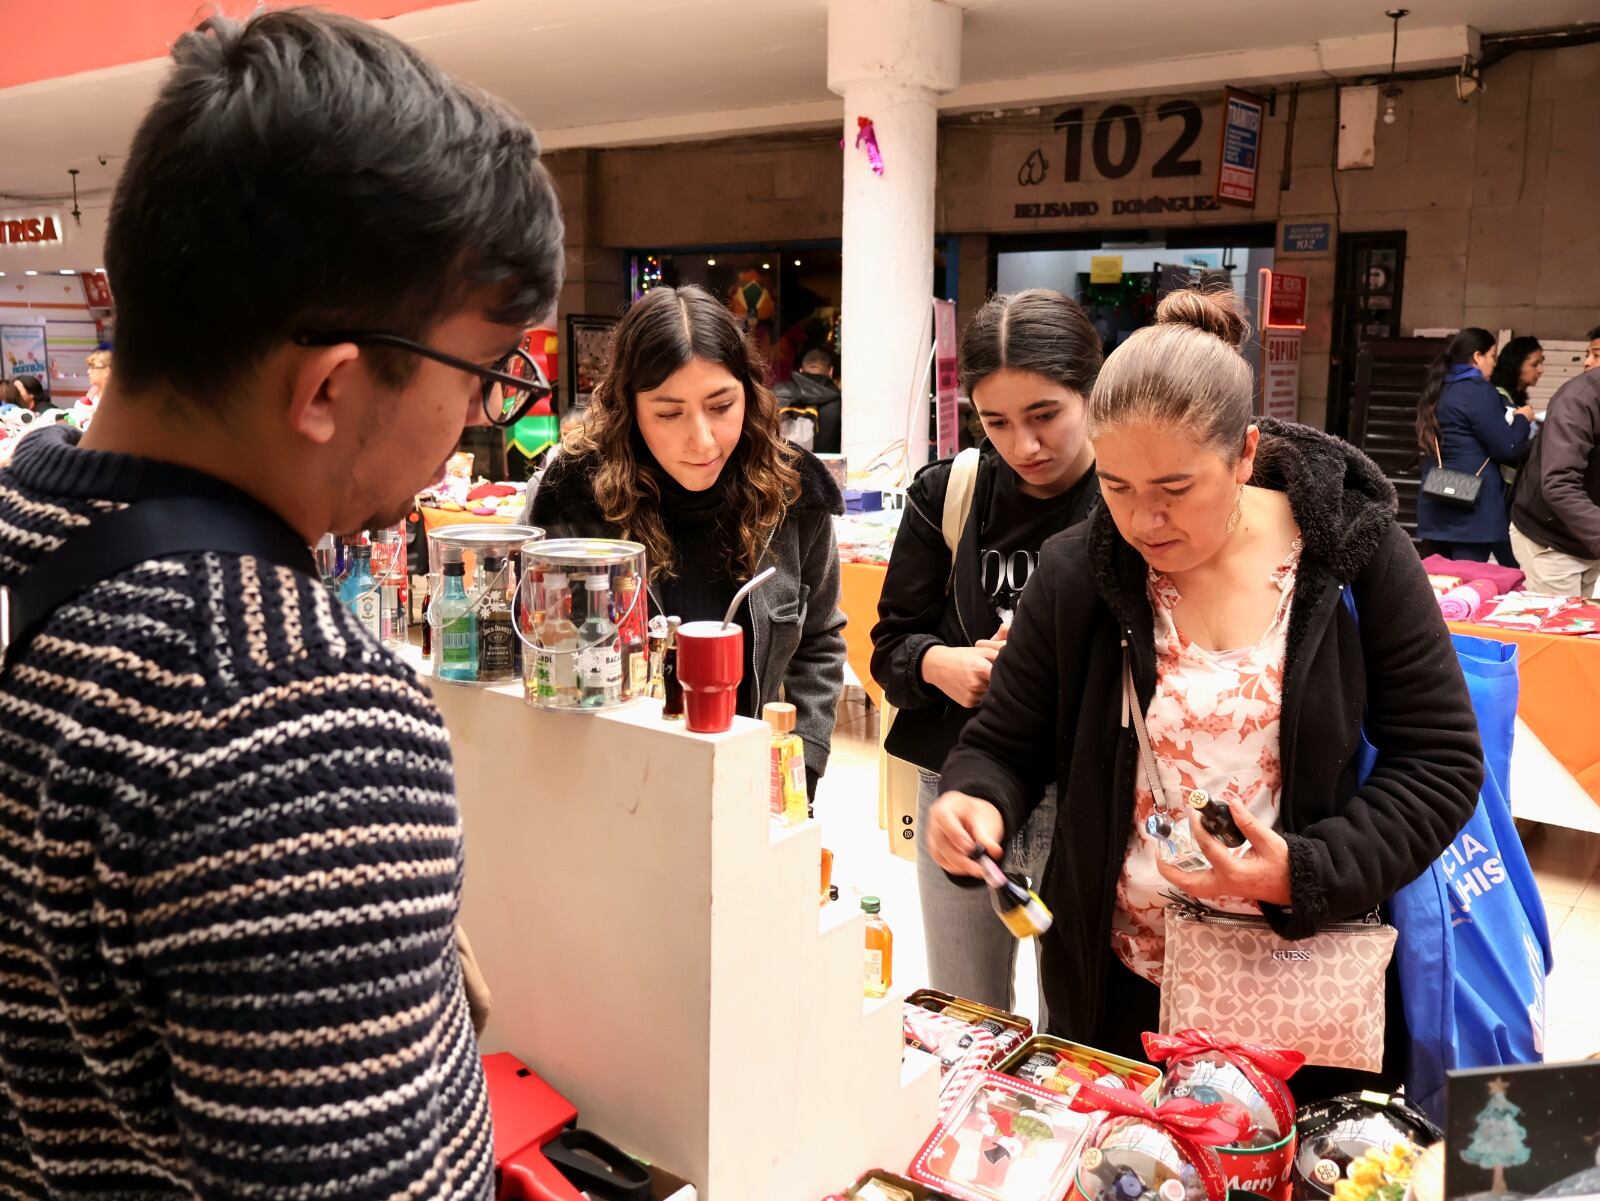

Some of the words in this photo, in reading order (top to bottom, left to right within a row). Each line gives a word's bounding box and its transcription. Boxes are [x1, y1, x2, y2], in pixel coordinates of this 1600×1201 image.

[1053, 99, 1203, 183] 102
[1014, 201, 1099, 218] BELISARIO
[1272, 950, 1311, 961] GUESS
[1218, 1174, 1277, 1193] Merry
